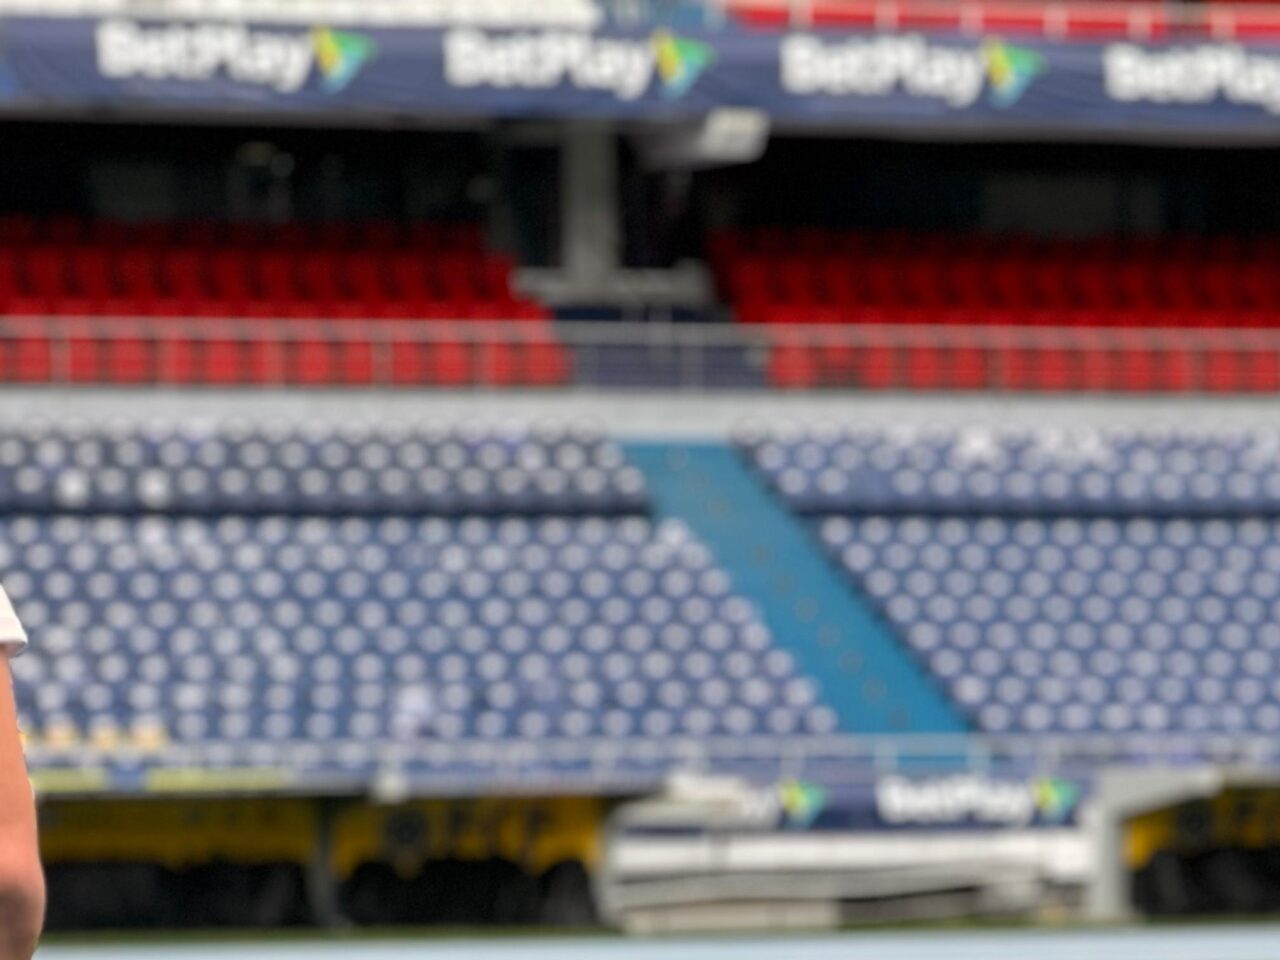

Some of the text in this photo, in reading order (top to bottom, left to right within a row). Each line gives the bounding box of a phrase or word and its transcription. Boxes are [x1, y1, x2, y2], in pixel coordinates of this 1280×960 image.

[96, 20, 312, 92] BetPlay
[444, 29, 652, 99] BetPlay
[780, 32, 982, 107] BetPlay
